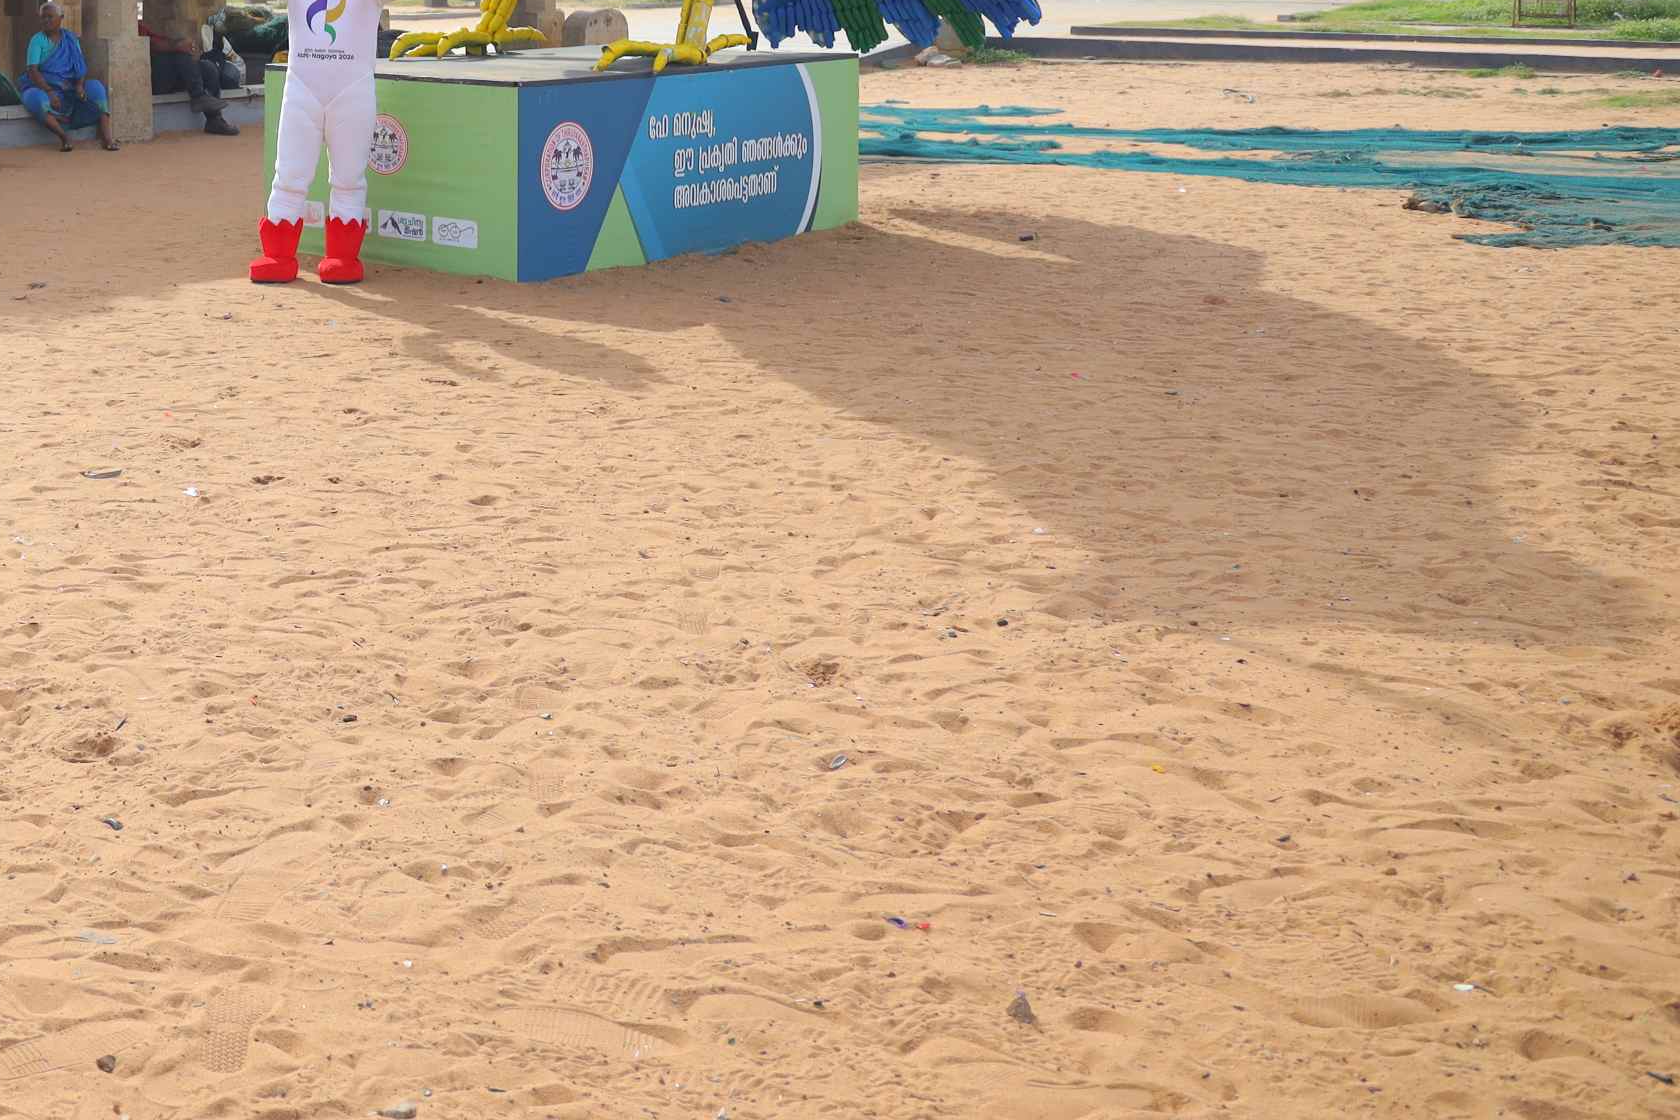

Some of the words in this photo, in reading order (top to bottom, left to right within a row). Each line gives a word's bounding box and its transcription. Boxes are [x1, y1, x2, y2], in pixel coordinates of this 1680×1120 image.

[649, 113, 669, 140] ഹേ
[674, 147, 694, 177] ഈ
[698, 136, 738, 174] പ്രകൃതി
